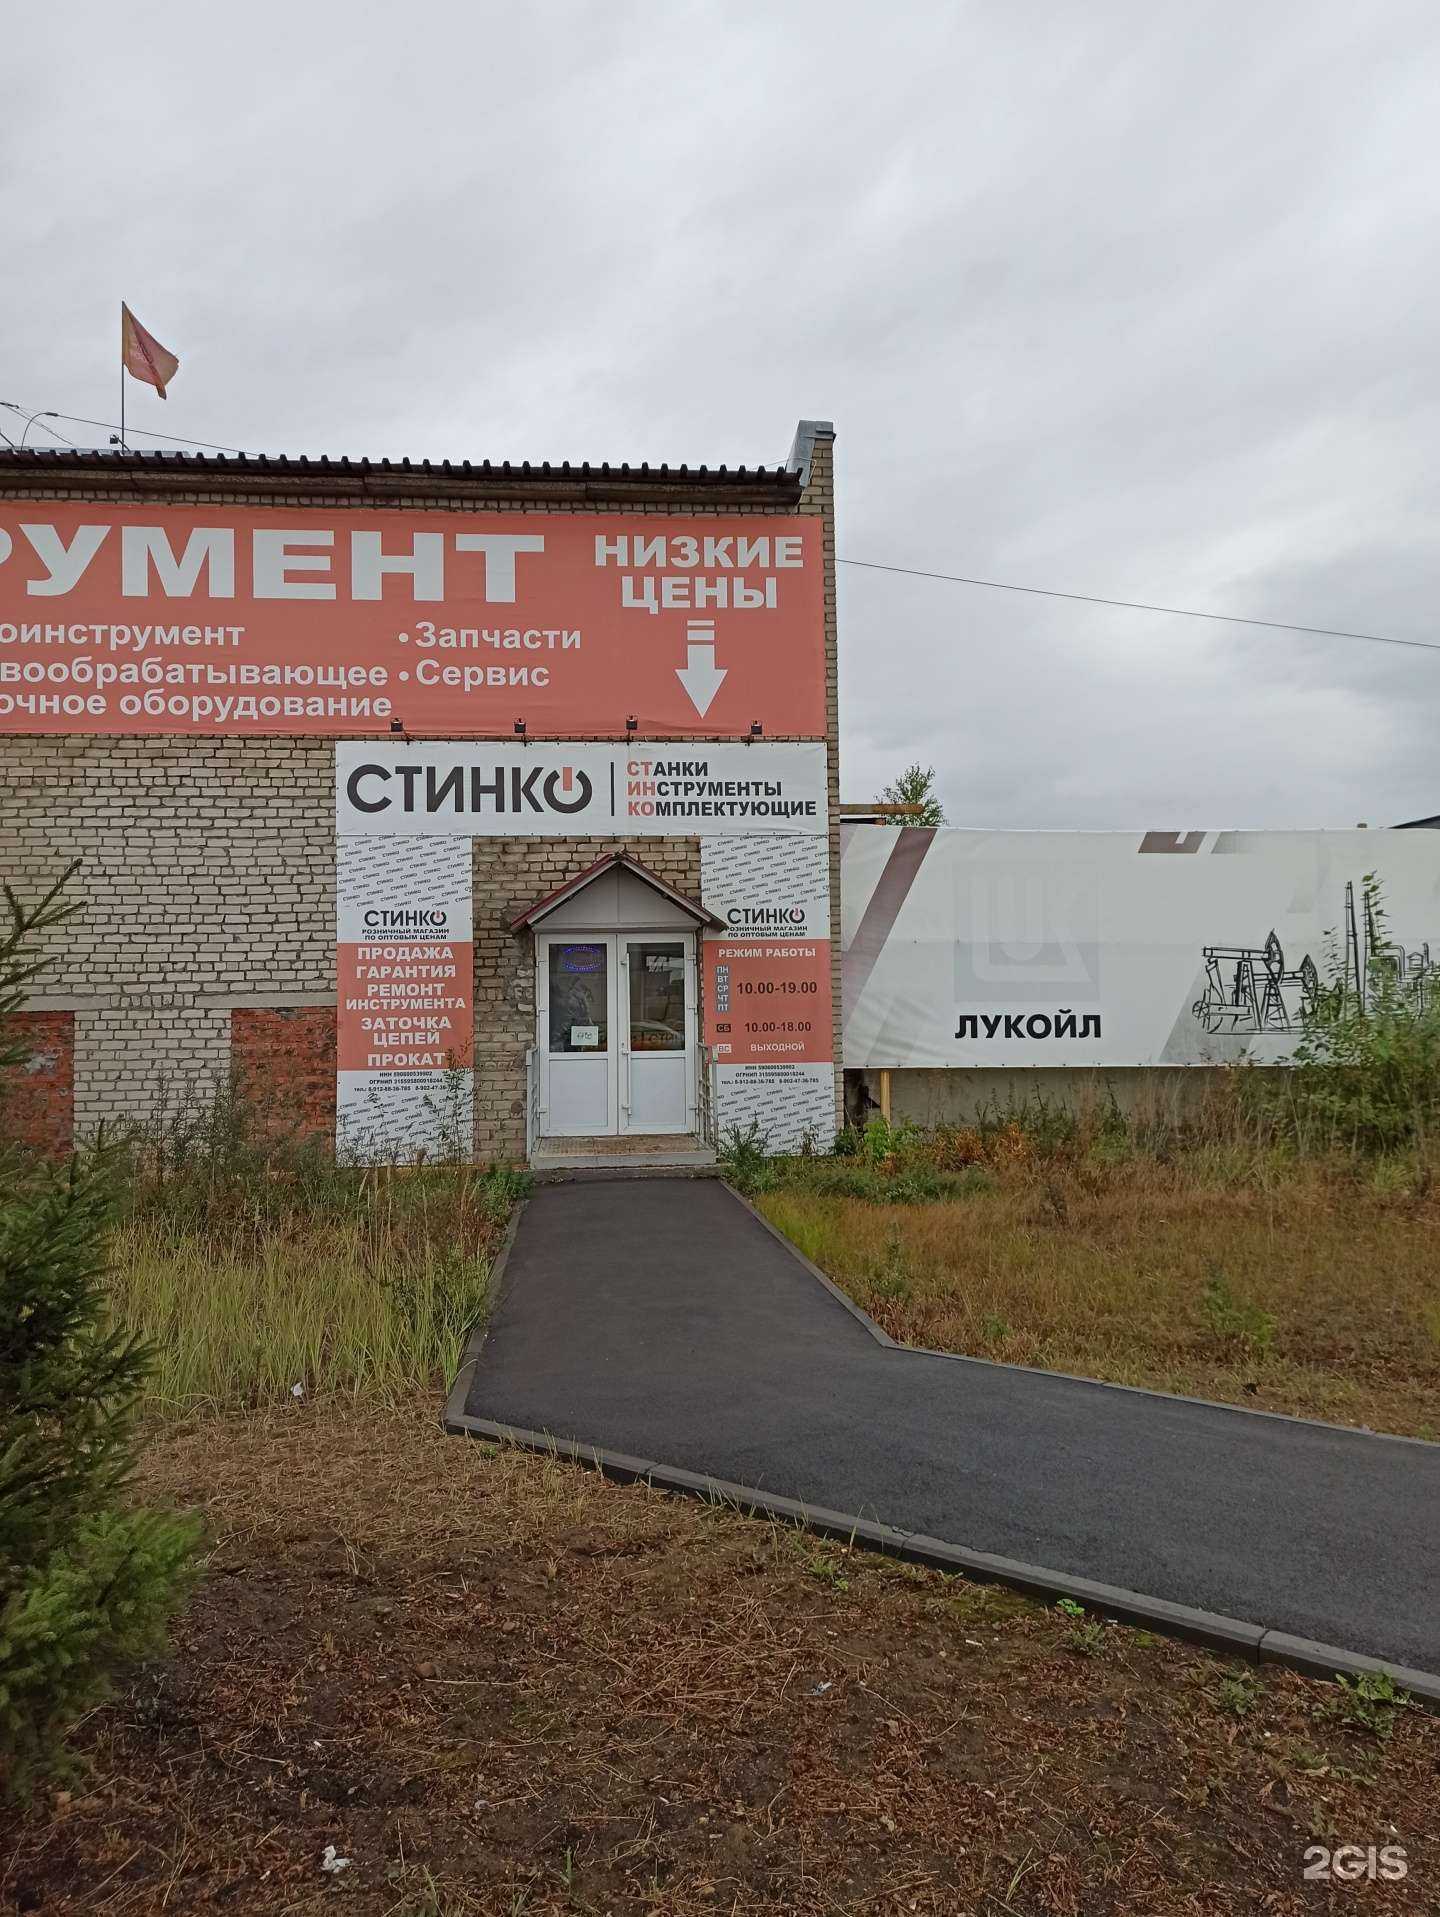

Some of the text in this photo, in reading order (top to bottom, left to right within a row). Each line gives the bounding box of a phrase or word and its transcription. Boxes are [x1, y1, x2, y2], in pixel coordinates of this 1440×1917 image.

[594, 534, 805, 568] НИЗКИЕ
[0, 524, 545, 603] УМЕНТ
[621, 575, 777, 614] ЦЕНЫ
[0, 623, 245, 651] оинструмент
[415, 621, 581, 649] Запчасти
[0, 656, 388, 689] вообрабатывающее
[416, 659, 549, 691] Сервис
[119, 687, 392, 722] оборудование
[627, 761, 709, 777] СТАНКИ
[346, 763, 592, 814] СТИНКО
[627, 781, 782, 797] ИНСТРУМЕНТЫ
[627, 800, 817, 818] КОМПЛЕКТУЮЩИЕ
[364, 910, 447, 927] СТИНКО
[727, 908, 805, 925] СТИНКО
[357, 946, 454, 962] ПРОДАЖА
[719, 948, 816, 958] РЕЖИМ РАБОТЫ
[356, 965, 456, 979] ГАРАНТИЯ
[717, 966, 729, 974] ПН
[717, 975, 729, 983] ВТ
[367, 983, 446, 997] РЕМОНТ
[717, 985, 729, 993] СР
[737, 981, 818, 995] 10.00-19.00
[346, 997, 466, 1010] ИНСТРУМЕНТА
[717, 994, 729, 1002] ЧТ
[718, 1003, 729, 1011] ПТ
[361, 1016, 452, 1030] ЗАТОЧКА
[745, 1021, 812, 1033] 10.00-18.00
[954, 1008, 1101, 1039] ЛУКОЙЛ
[373, 1028, 440, 1047] ЦЕПЕЙ
[750, 1042, 805, 1052] ВЫХОДНОЙ
[367, 1052, 446, 1066] ПРОКАТ
